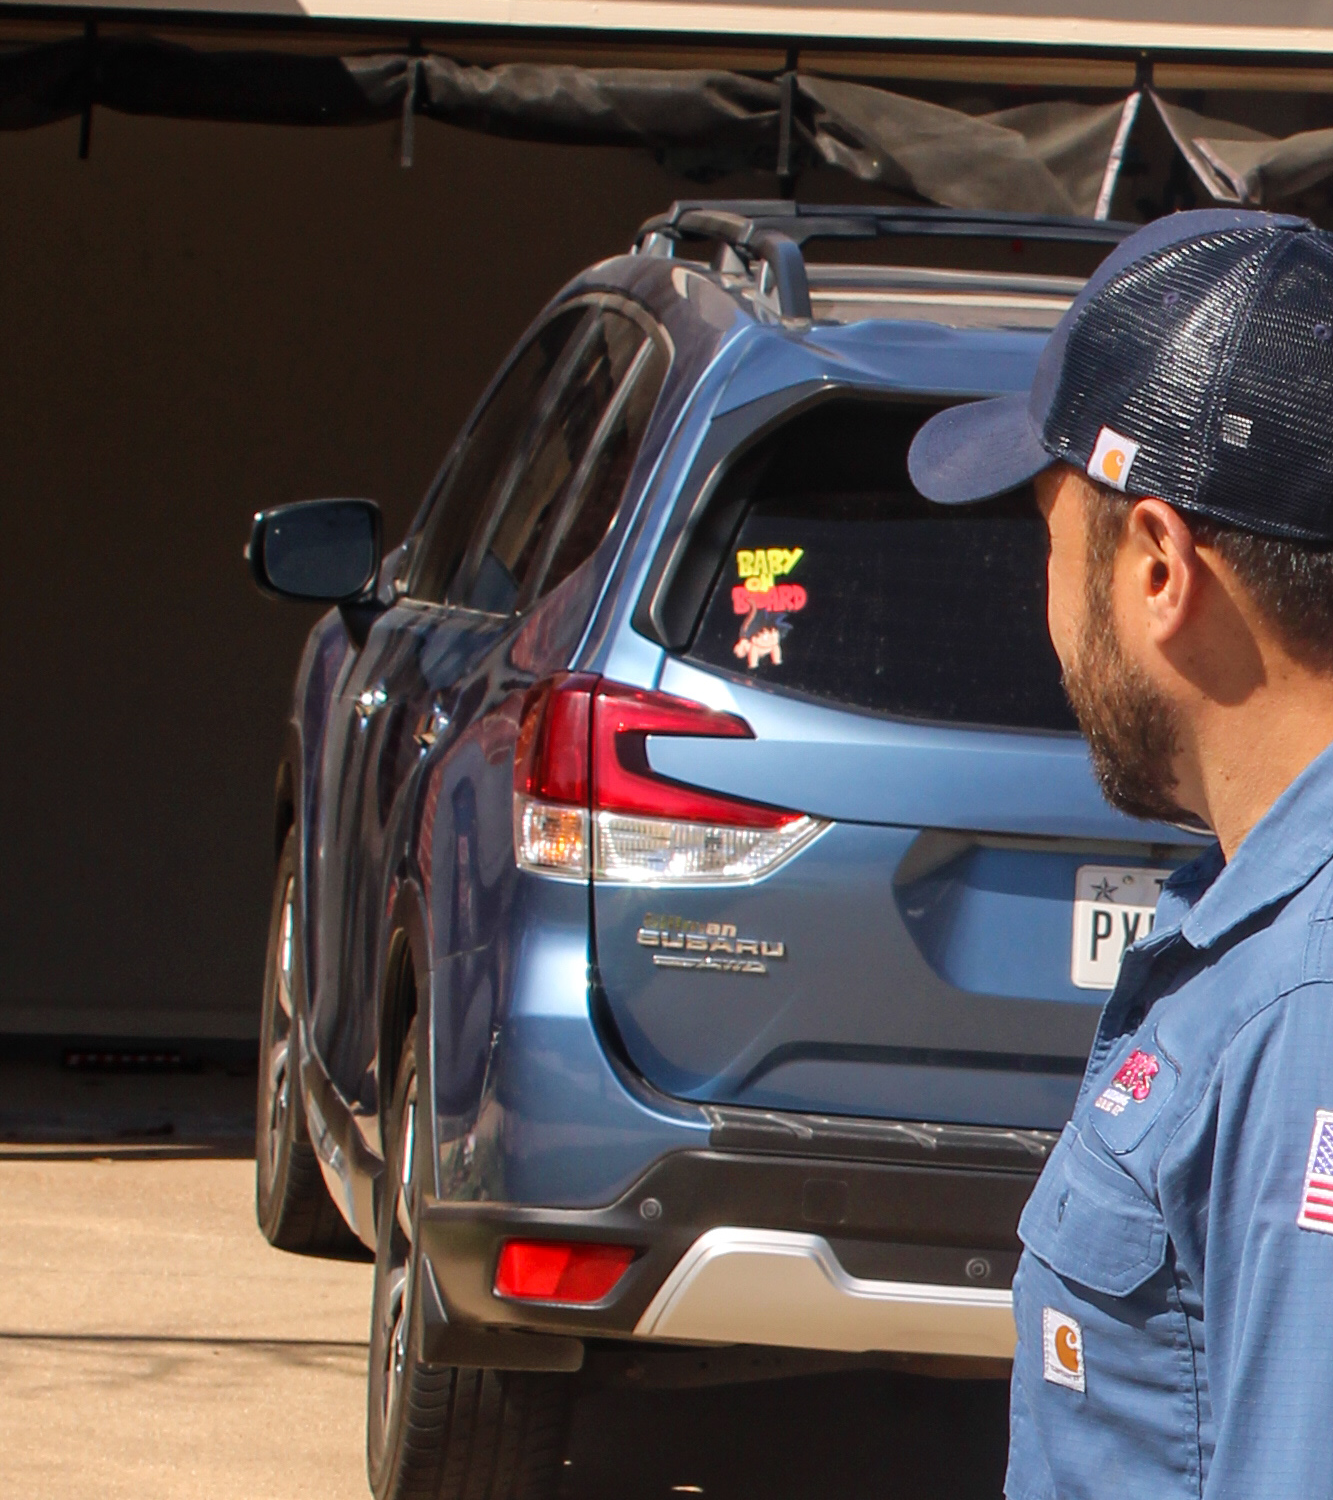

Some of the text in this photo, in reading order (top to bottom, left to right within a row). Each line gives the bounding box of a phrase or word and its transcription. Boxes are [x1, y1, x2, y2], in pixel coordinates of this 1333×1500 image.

[736, 547, 804, 578] BABY
[744, 572, 775, 592] ON
[731, 583, 808, 614] BOARD
[637, 928, 785, 957] SUBARU
[1089, 908, 1155, 962] PX
